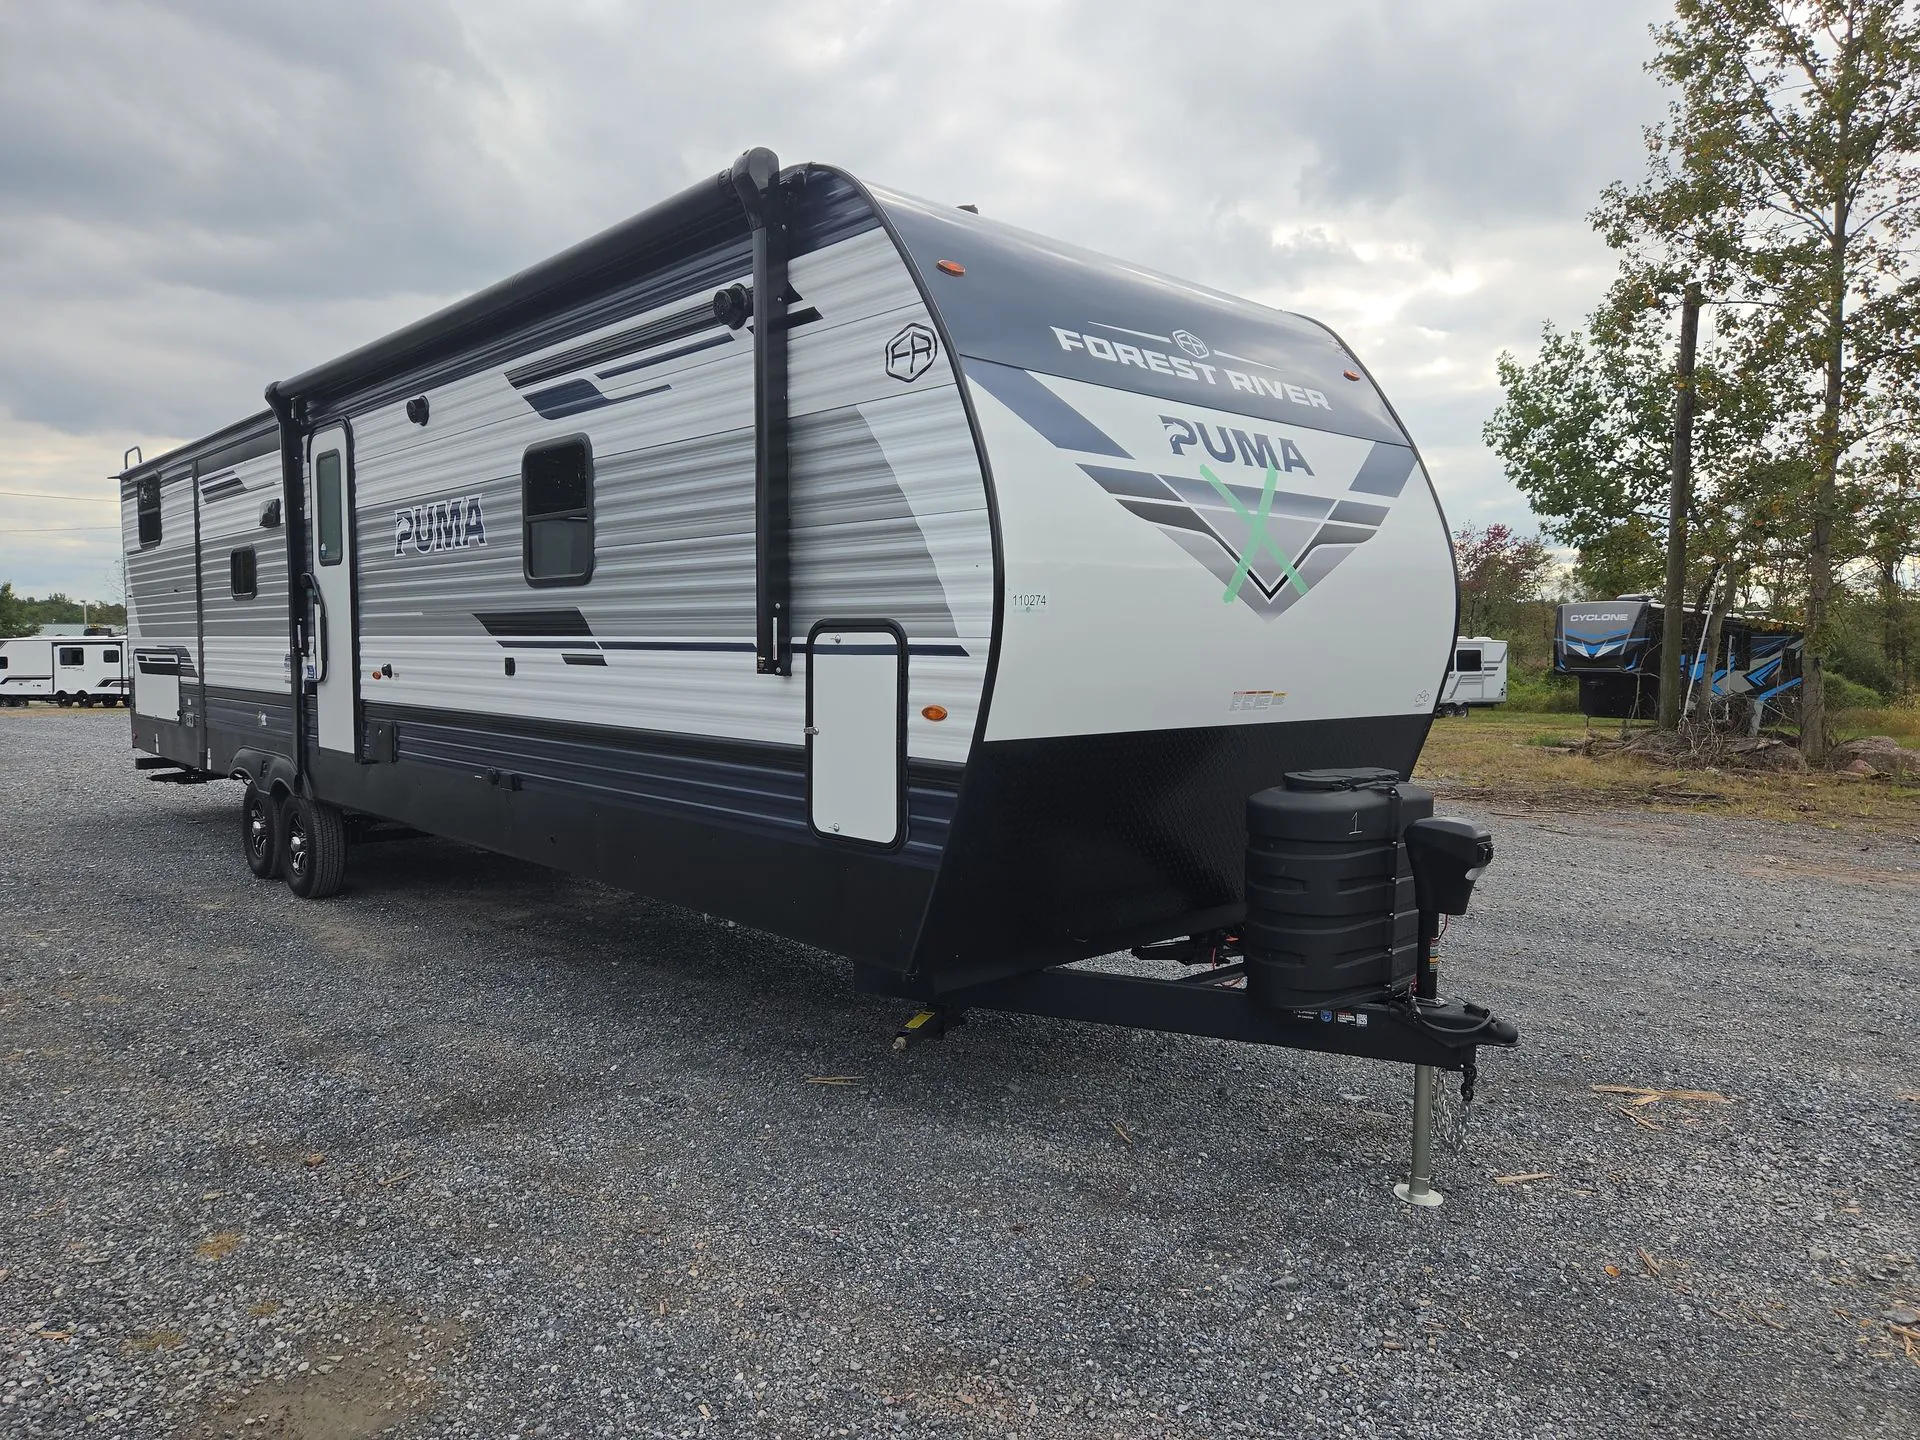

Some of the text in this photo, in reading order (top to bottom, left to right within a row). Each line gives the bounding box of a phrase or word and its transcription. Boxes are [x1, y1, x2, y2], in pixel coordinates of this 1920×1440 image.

[1050, 325, 1333, 411] FOREST RIVER
[1158, 414, 1316, 477] PUMA
[394, 493, 488, 557] PUMA
[1012, 594, 1047, 606] 110274
[1570, 613, 1629, 622] CYCLONE
